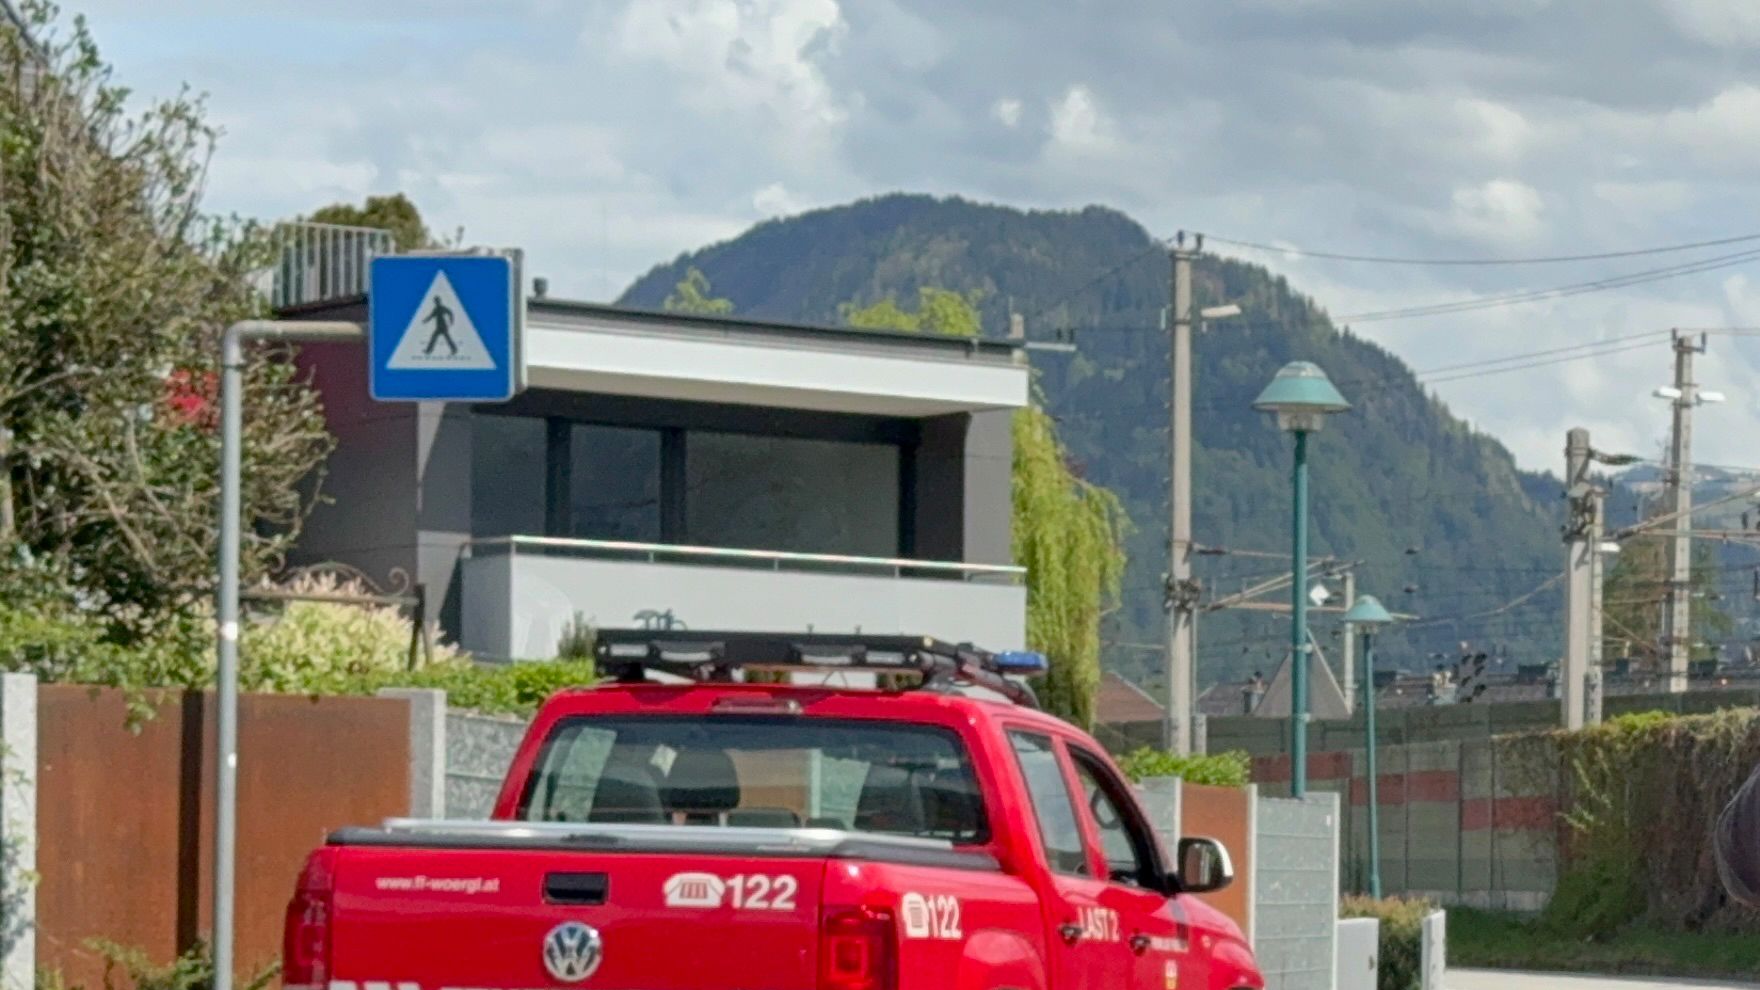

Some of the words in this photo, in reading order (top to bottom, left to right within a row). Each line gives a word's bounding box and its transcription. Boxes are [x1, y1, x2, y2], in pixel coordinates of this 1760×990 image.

[725, 874, 797, 908] 122
[928, 895, 961, 938] 122
[1077, 906, 1109, 941] LAST
